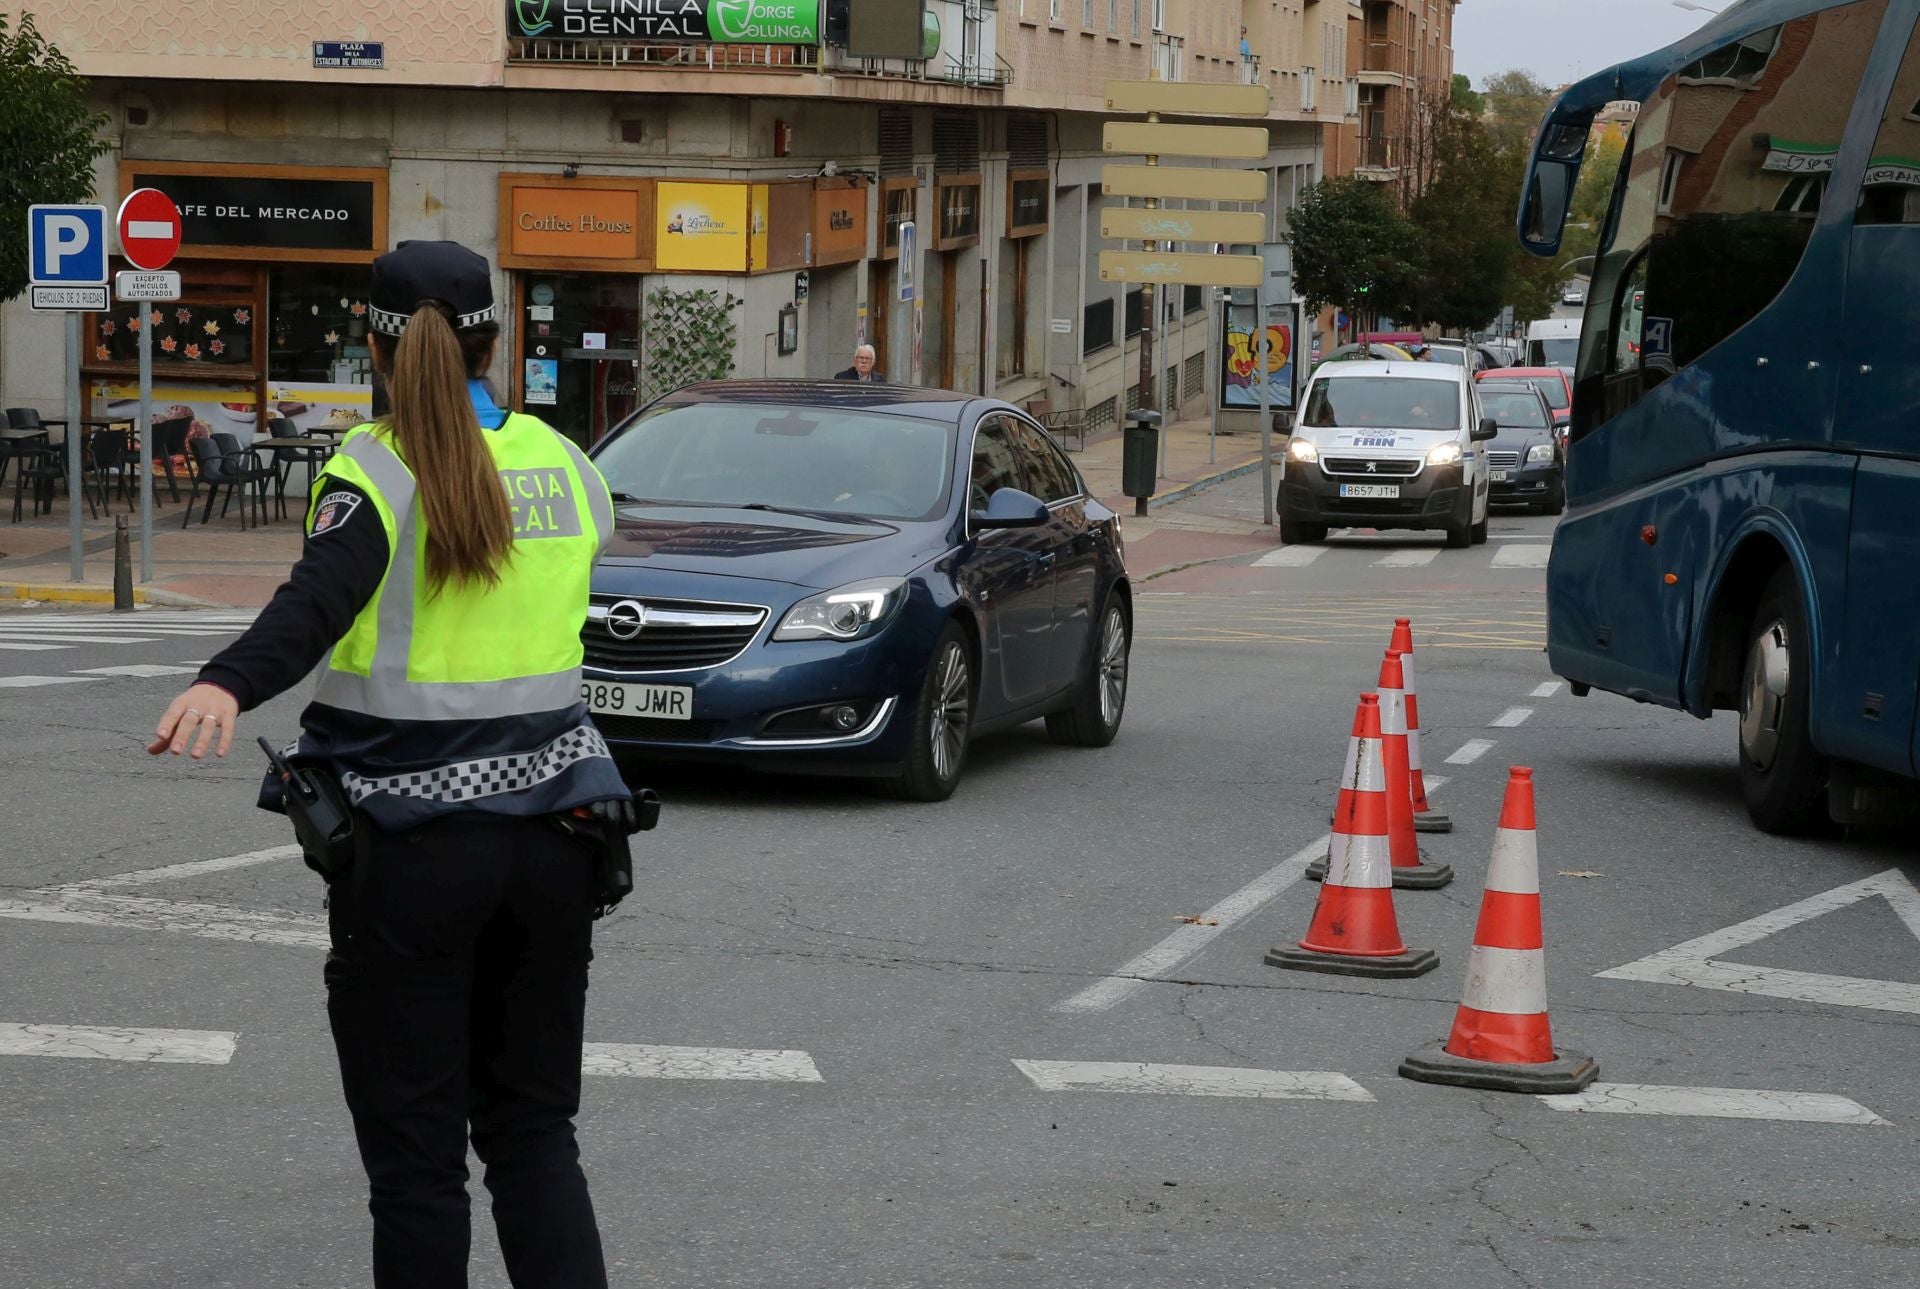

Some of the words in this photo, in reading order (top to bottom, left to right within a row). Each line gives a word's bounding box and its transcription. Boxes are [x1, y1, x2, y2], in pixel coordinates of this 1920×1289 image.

[563, 15, 704, 36] DENTAL
[339, 43, 365, 51] PLAZA
[315, 57, 341, 66] ESTACION
[341, 58, 350, 66] DE
[351, 58, 382, 67] AUTOBUSES
[174, 204, 207, 217] AFE
[215, 206, 250, 218] DEL
[258, 207, 349, 221] MERCADO
[518, 211, 573, 232] Coffee
[578, 213, 633, 234] House
[44, 214, 90, 275] P
[135, 274, 166, 283] EXCEPTO
[66, 292, 75, 304] DE
[76, 293, 81, 304] 2
[82, 293, 104, 305] RUEDAS
[127, 289, 174, 298] AUTORIZADOS
[1352, 436, 1396, 447] FRIN
[503, 473, 565, 499] ICIA
[1347, 484, 1373, 496] 8657
[1377, 485, 1397, 497] JTH
[511, 505, 560, 533] CAL
[581, 684, 625, 710] 989
[635, 688, 685, 715] JMR
